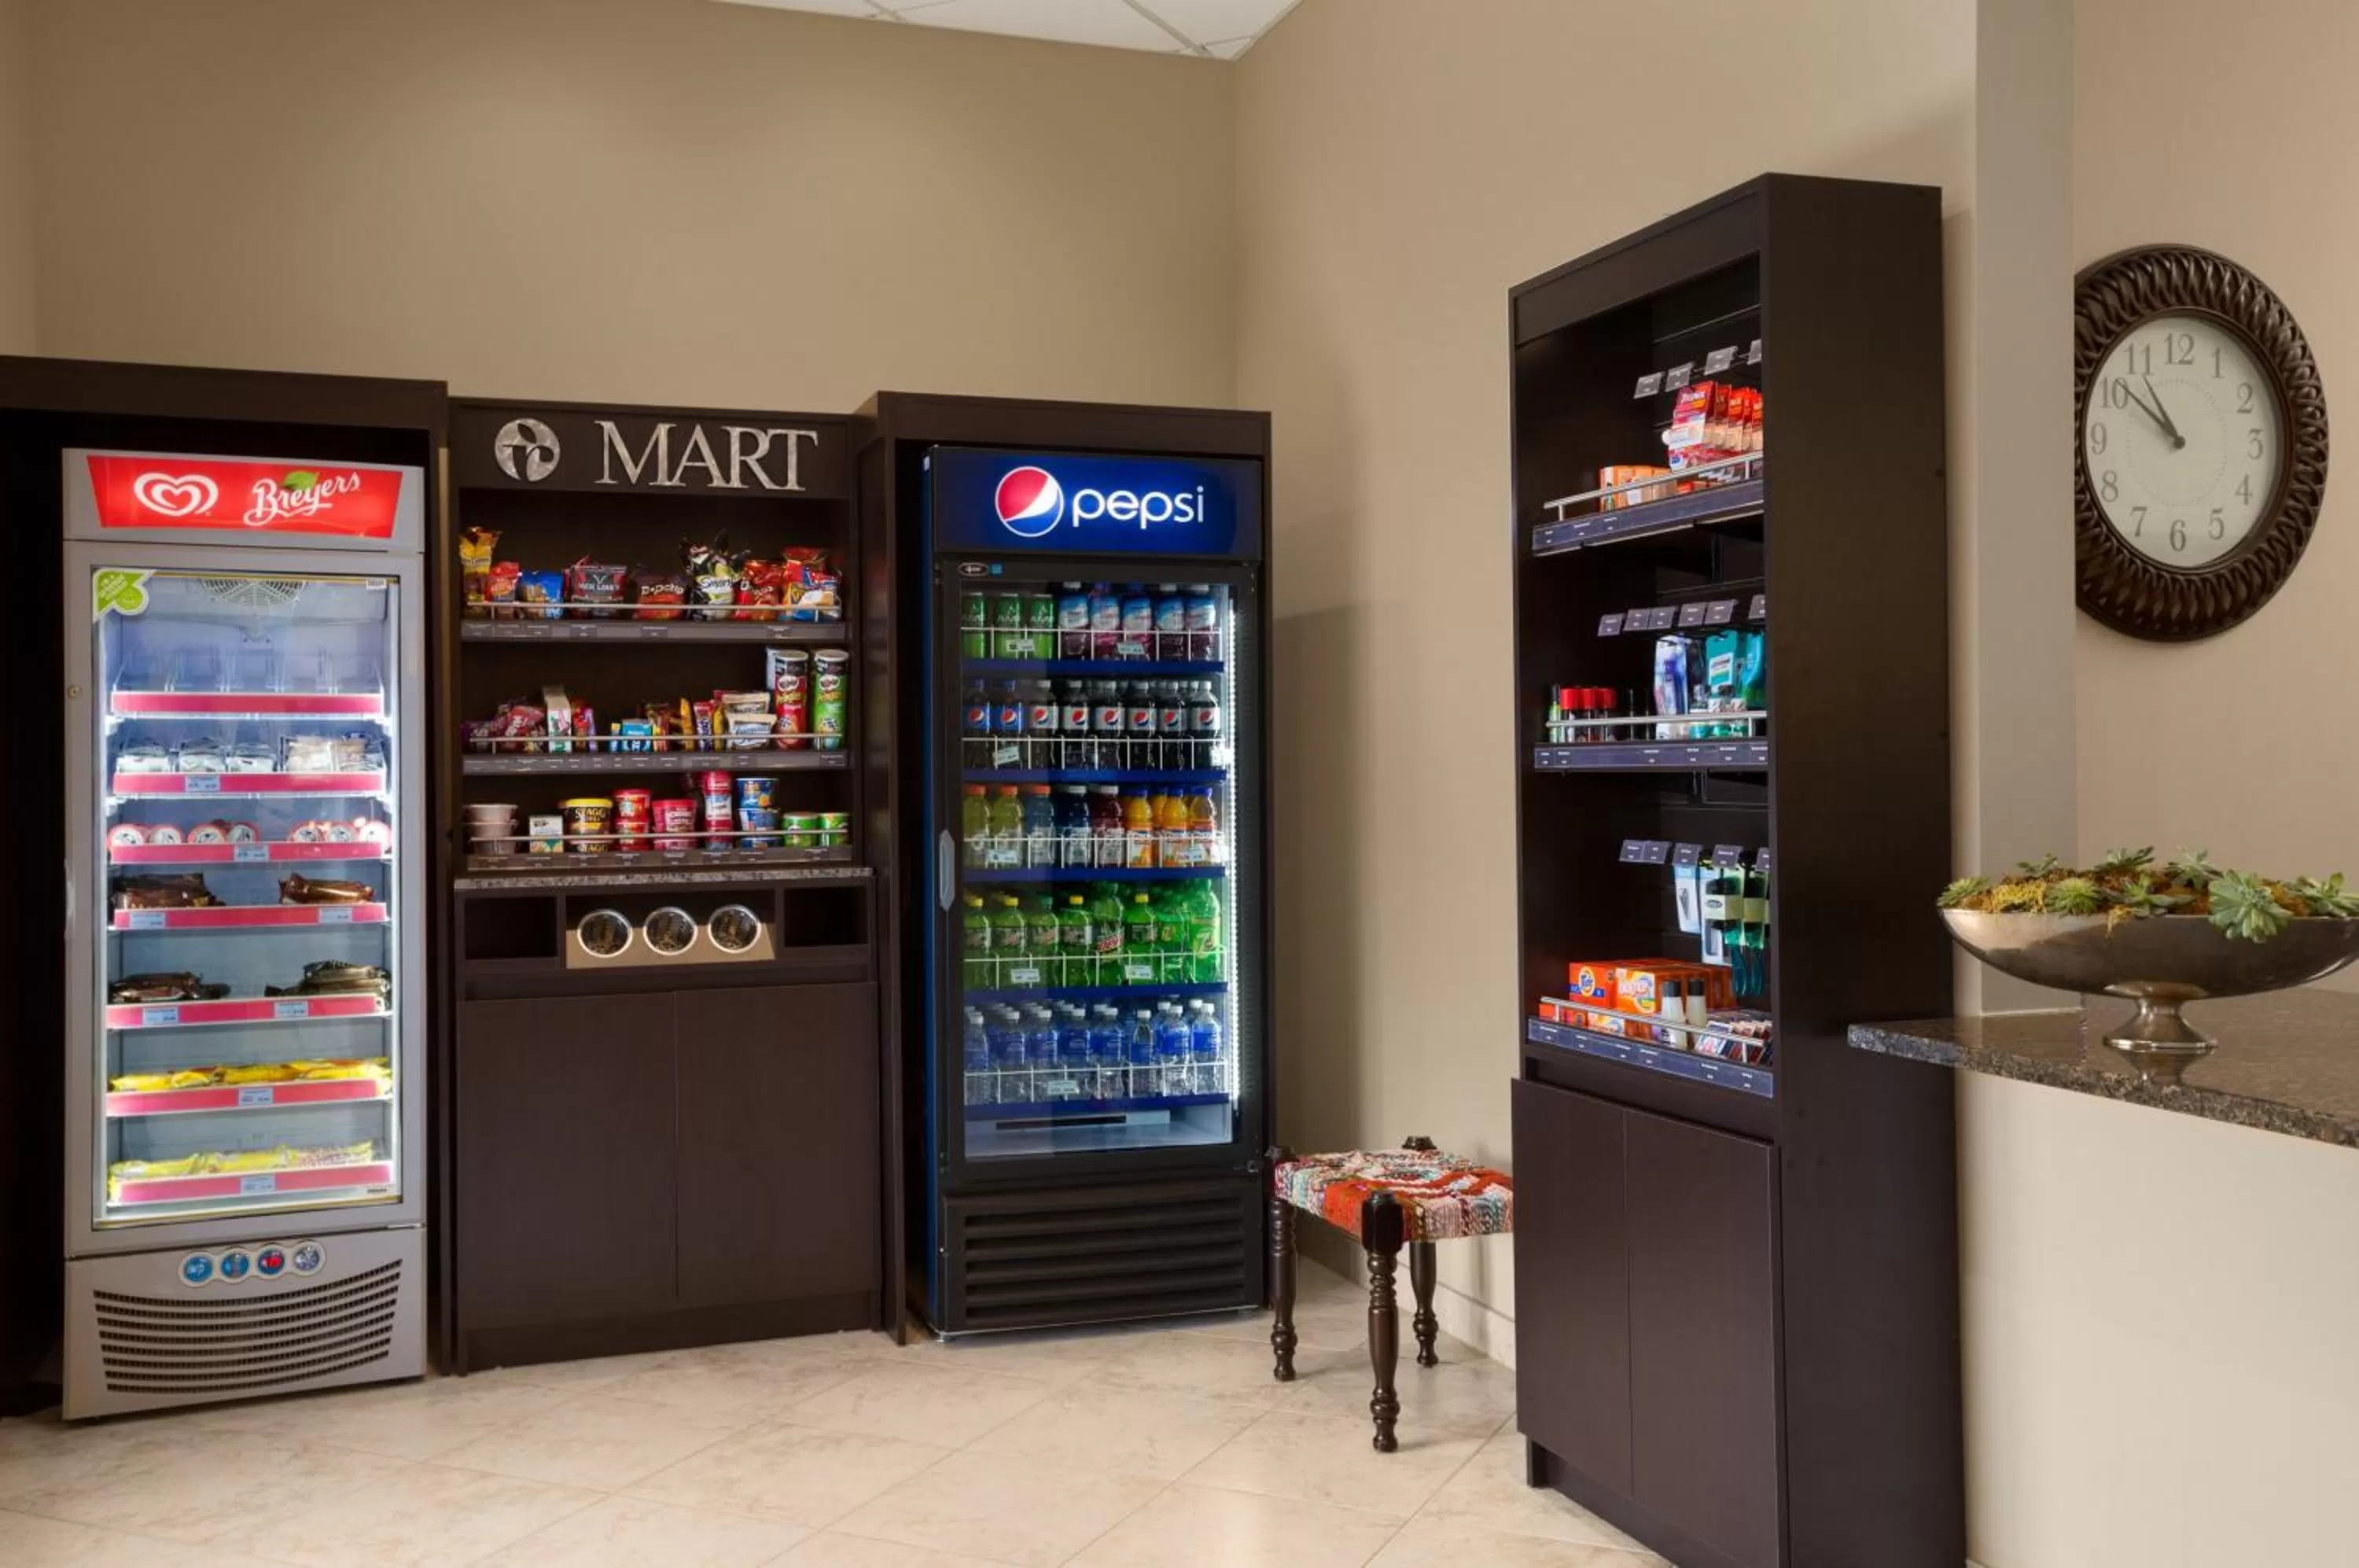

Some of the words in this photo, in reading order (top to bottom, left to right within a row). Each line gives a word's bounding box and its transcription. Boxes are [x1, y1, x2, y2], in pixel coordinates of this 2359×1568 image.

[2125, 343, 2155, 376] 11
[2164, 333, 2195, 365] 12
[2210, 347, 2225, 378] 1
[2100, 377, 2129, 409] 10
[2236, 383, 2254, 414] 2
[2090, 423, 2108, 455] 9
[2247, 428, 2264, 459] 3
[594, 420, 818, 491] MART
[243, 471, 361, 526] Breyers
[2101, 470, 2119, 502] 8
[2236, 473, 2253, 506] 4
[1072, 485, 1205, 529] pepsi
[2129, 506, 2147, 537] 7
[2169, 519, 2187, 551] 6
[2208, 509, 2225, 540] 5
